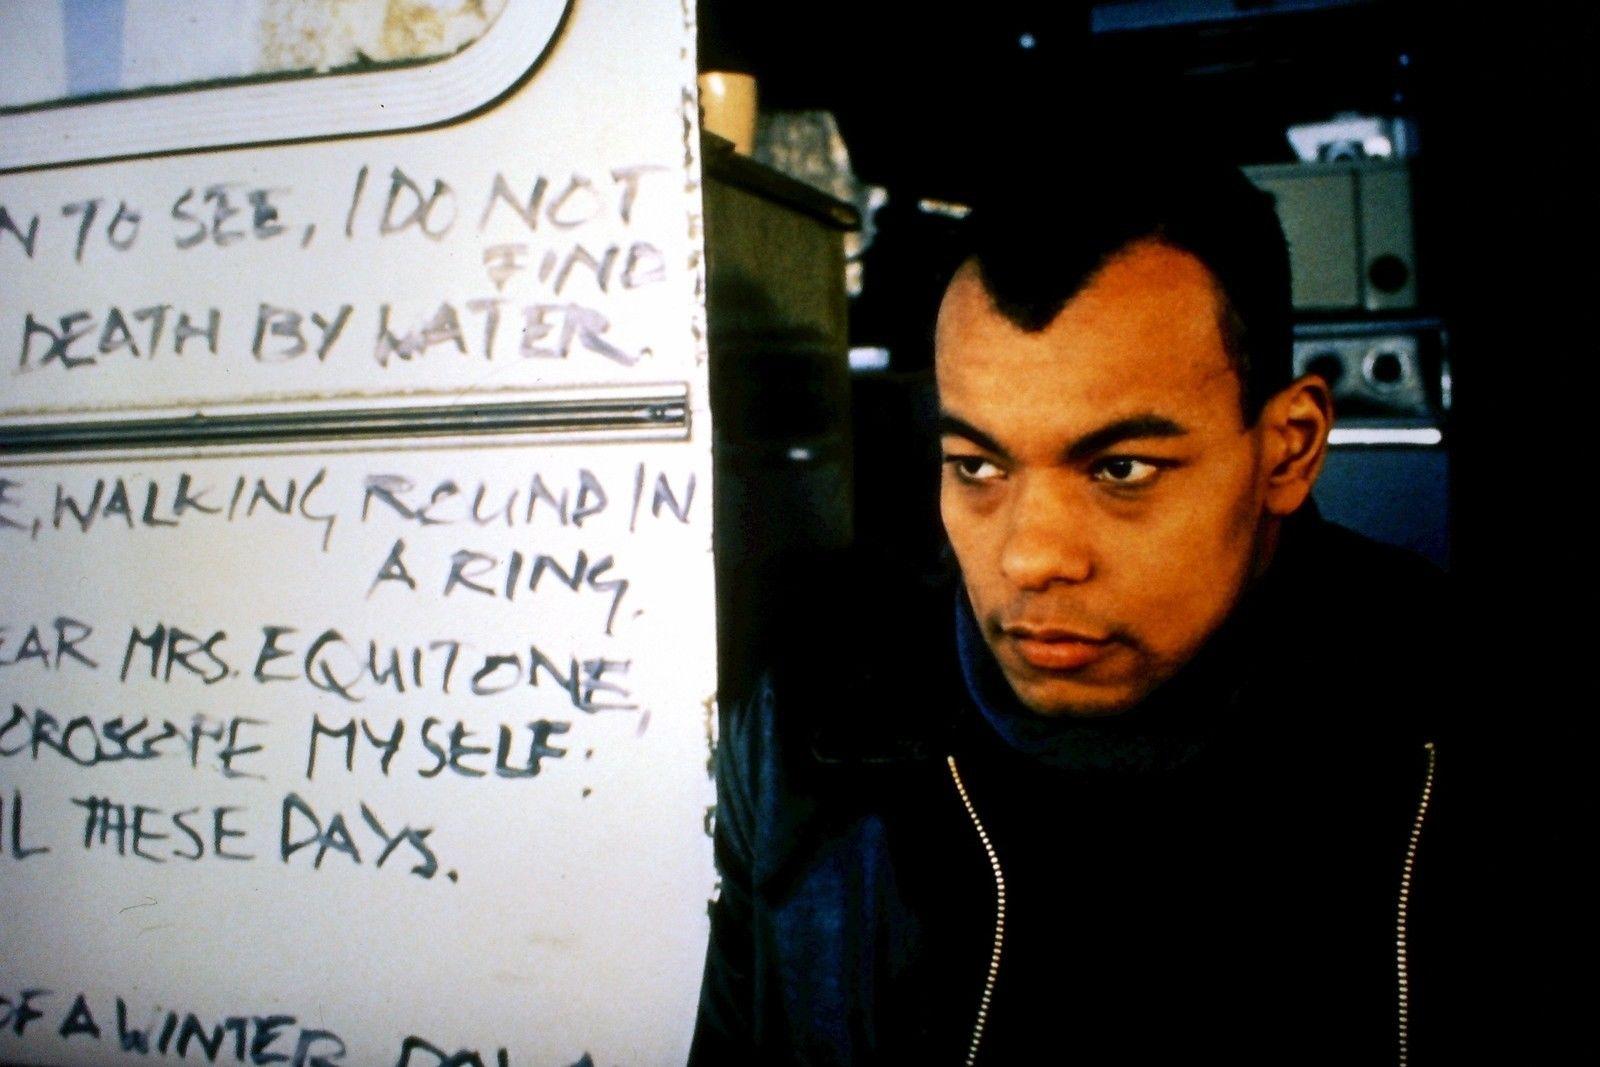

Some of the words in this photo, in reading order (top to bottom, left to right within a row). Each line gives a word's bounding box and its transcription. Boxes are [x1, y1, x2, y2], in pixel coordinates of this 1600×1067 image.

[61, 198, 141, 263] TO
[171, 183, 316, 251] SEE,
[380, 167, 457, 242] DO
[477, 165, 670, 231] NOT
[483, 243, 666, 295] FIND
[16, 305, 220, 368] DEATH
[252, 303, 354, 362] BY
[629, 462, 696, 533] IN
[366, 537, 416, 598] A
[443, 550, 644, 636] RING.
[121, 622, 240, 684] MRS.
[71, 796, 255, 863] THESE
[59, 992, 100, 1040] A
